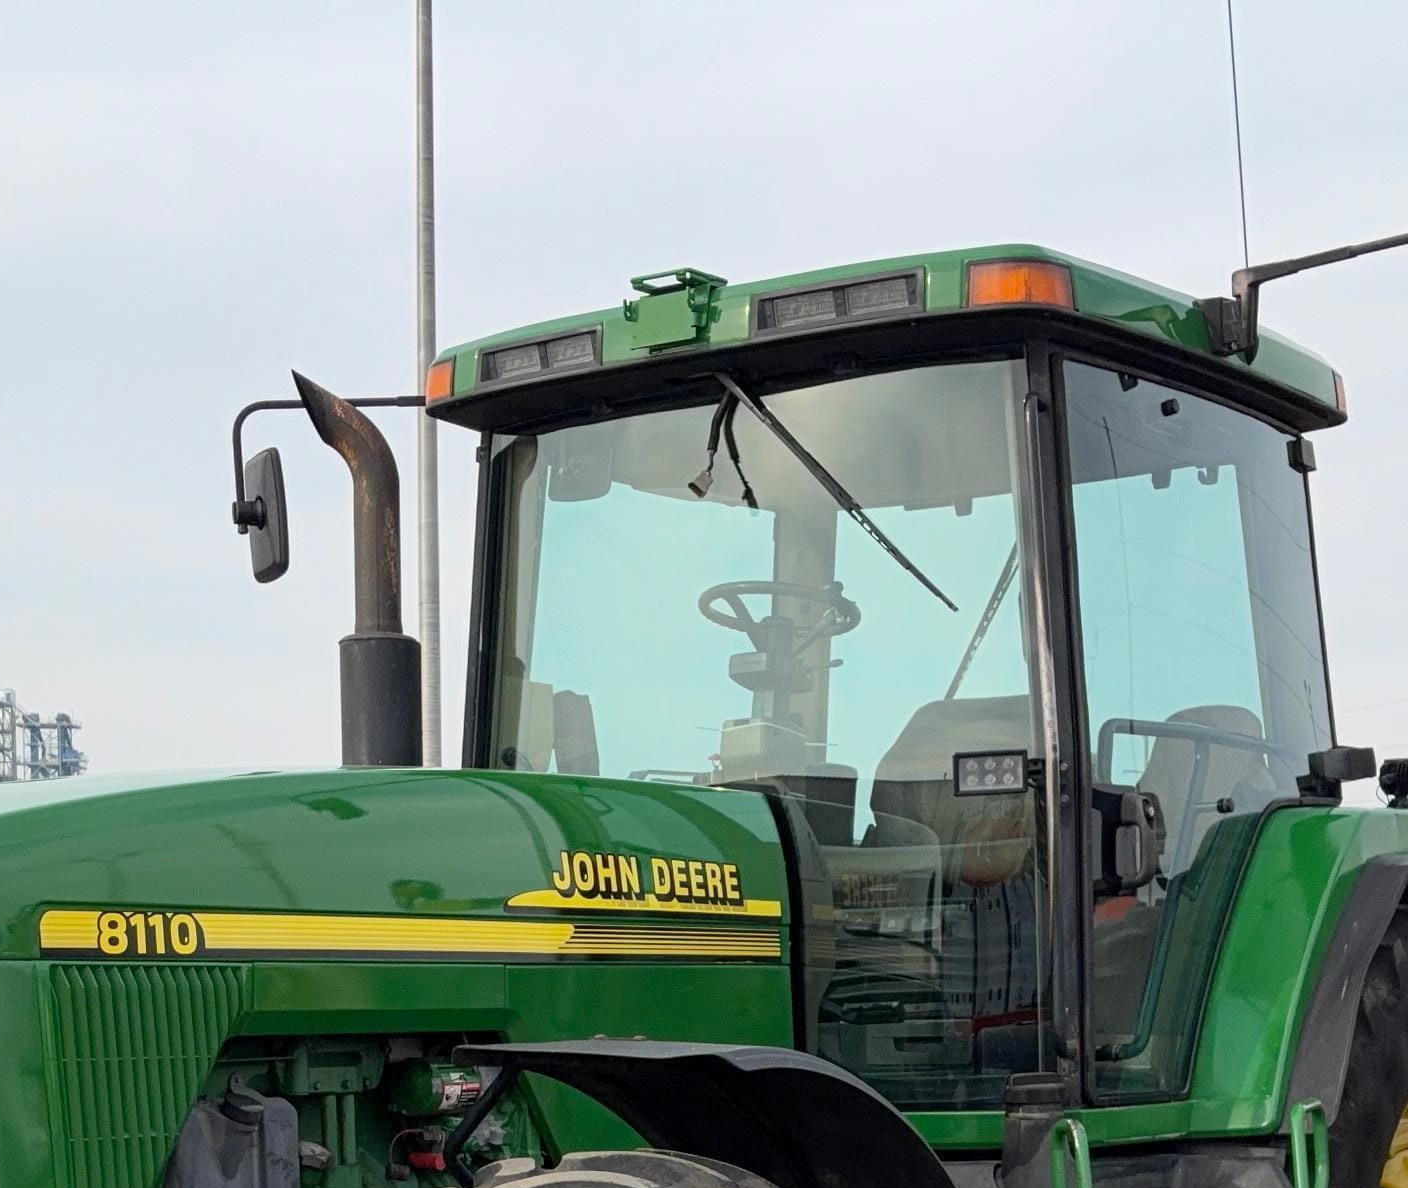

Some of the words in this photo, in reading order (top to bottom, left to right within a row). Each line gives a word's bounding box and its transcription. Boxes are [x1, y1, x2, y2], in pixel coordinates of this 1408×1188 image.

[552, 850, 641, 893] JOHN
[650, 857, 740, 899] DEERE
[98, 912, 198, 955] 8110
